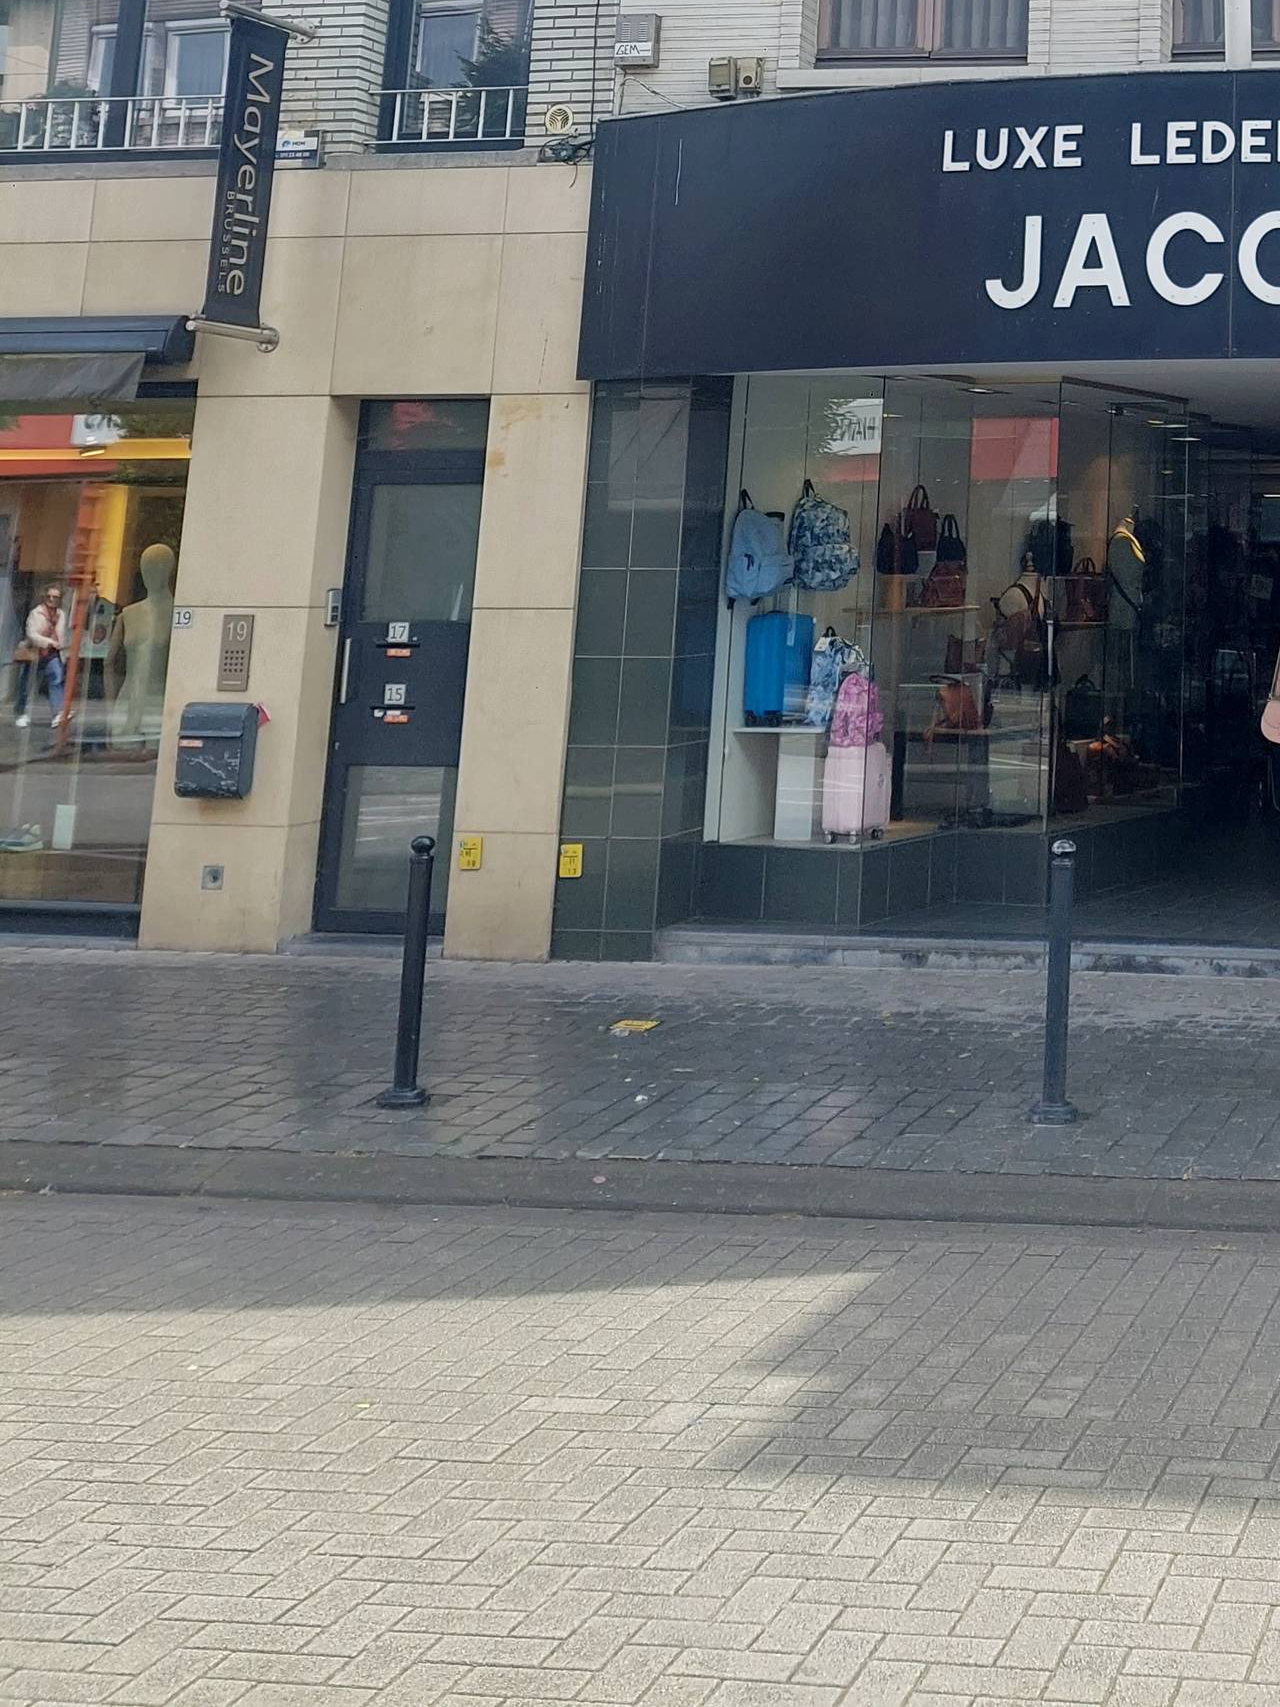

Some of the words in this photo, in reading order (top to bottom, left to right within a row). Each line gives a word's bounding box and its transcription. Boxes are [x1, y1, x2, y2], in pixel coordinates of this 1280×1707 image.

[942, 124, 1084, 172] LUXE
[226, 52, 275, 296] Mayerline
[217, 190, 236, 294] BRUSSELS
[175, 610, 191, 625] 19
[227, 621, 248, 641] 19
[390, 625, 406, 639] 17
[387, 687, 403, 702] 15
